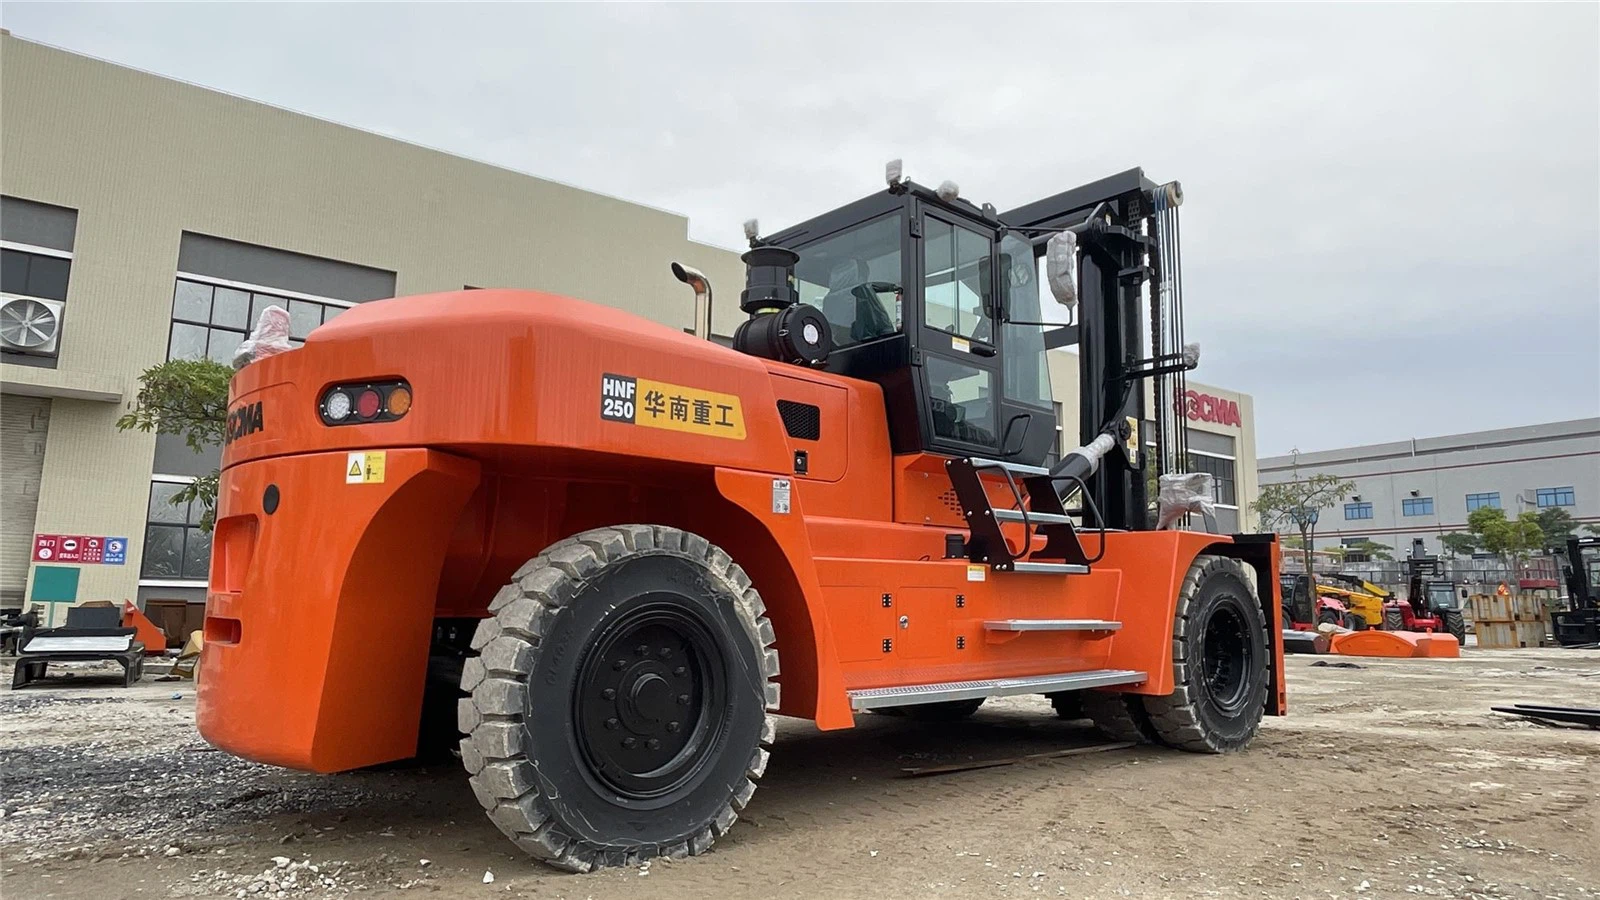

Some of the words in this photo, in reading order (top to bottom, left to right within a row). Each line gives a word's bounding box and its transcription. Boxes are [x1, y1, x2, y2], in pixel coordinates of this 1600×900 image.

[603, 378, 636, 399] HNF
[603, 398, 634, 419] 250
[644, 390, 735, 428] 华南重工
[1174, 389, 1241, 427] OCMA
[42, 549, 49, 557] 3
